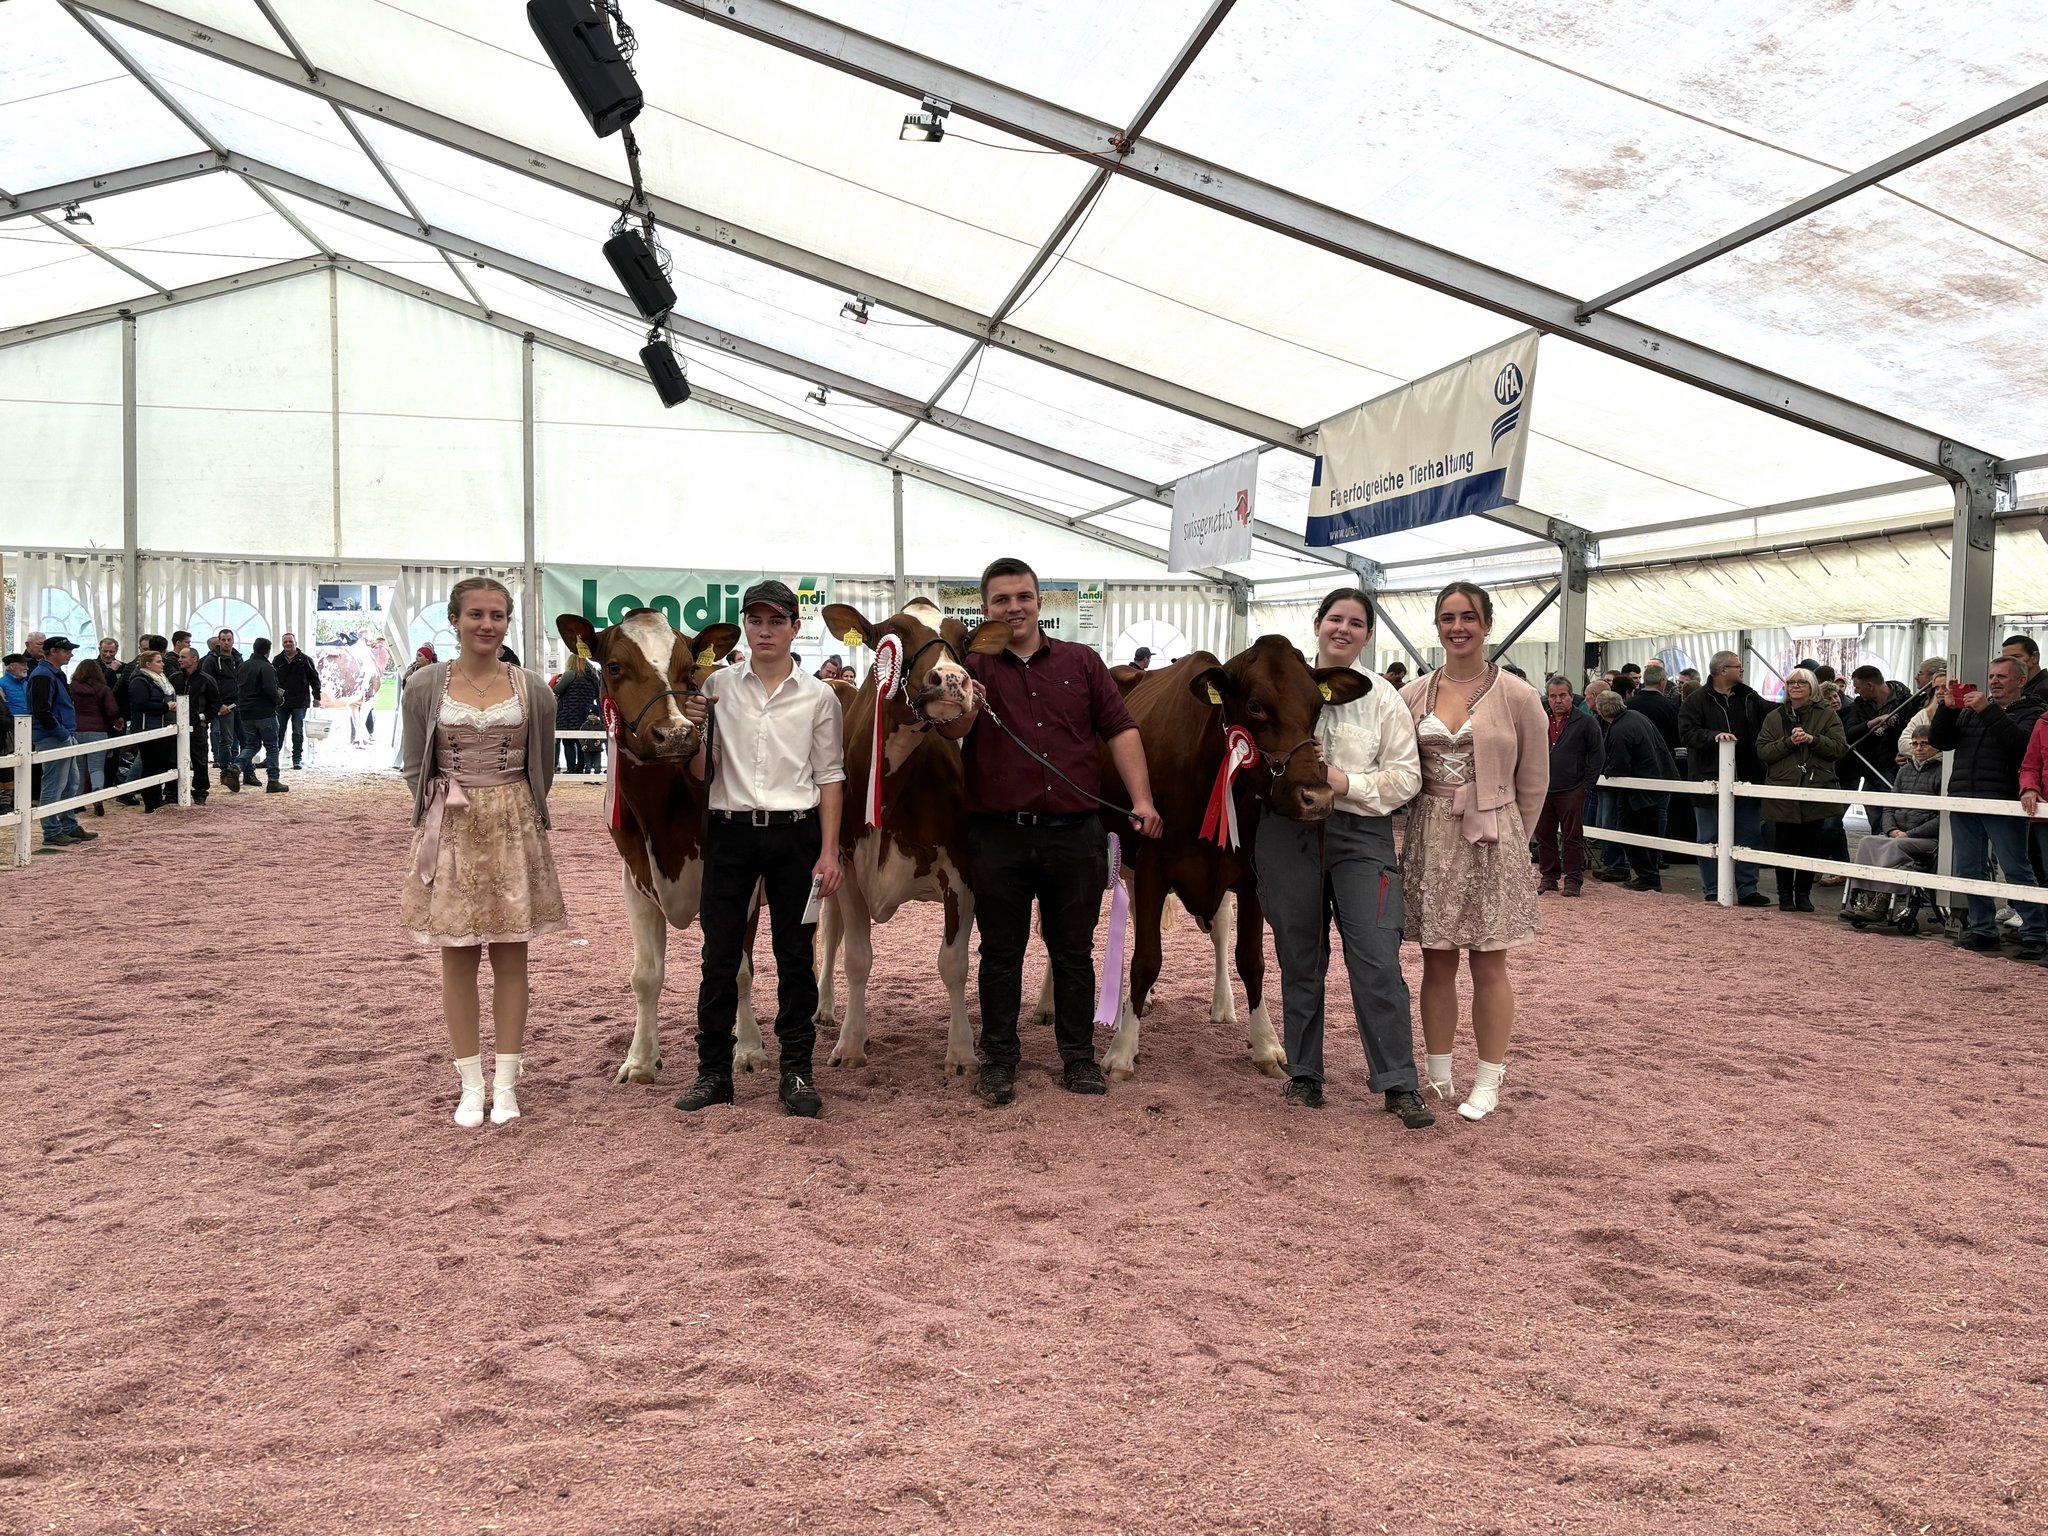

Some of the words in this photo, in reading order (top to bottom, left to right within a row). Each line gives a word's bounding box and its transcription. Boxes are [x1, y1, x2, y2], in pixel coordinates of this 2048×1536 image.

[1497, 364, 1520, 402] UFA
[1343, 472, 1404, 504] erfolgreiche
[1409, 451, 1474, 486] Tierhaltung
[1184, 503, 1233, 545] swissgenetics
[944, 606, 954, 615] Ihr
[1078, 590, 1103, 600] Landi
